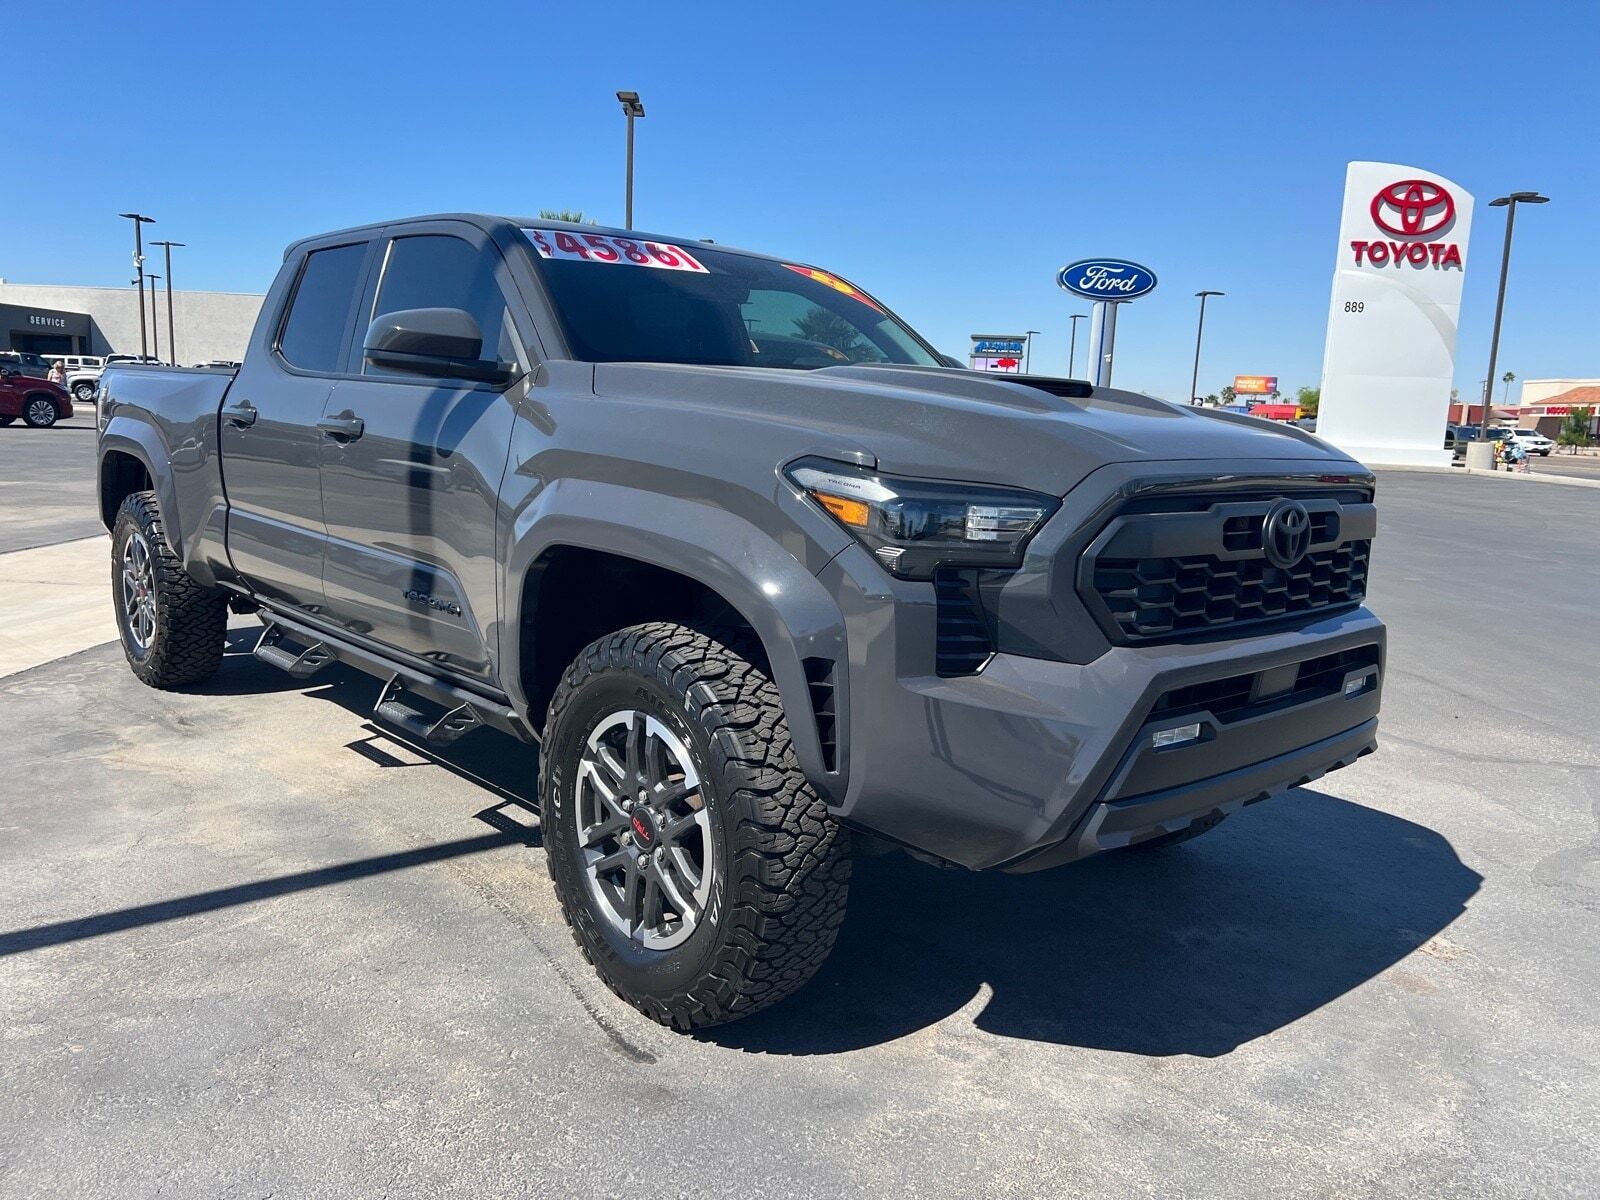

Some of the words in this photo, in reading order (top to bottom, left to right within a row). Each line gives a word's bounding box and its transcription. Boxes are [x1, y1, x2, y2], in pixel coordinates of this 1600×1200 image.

[1350, 240, 1462, 267] TOYOTA
[1079, 265, 1138, 292] Ford
[1344, 301, 1364, 312] 889
[30, 315, 65, 327] SERVICE
[827, 478, 861, 489] TACOMA
